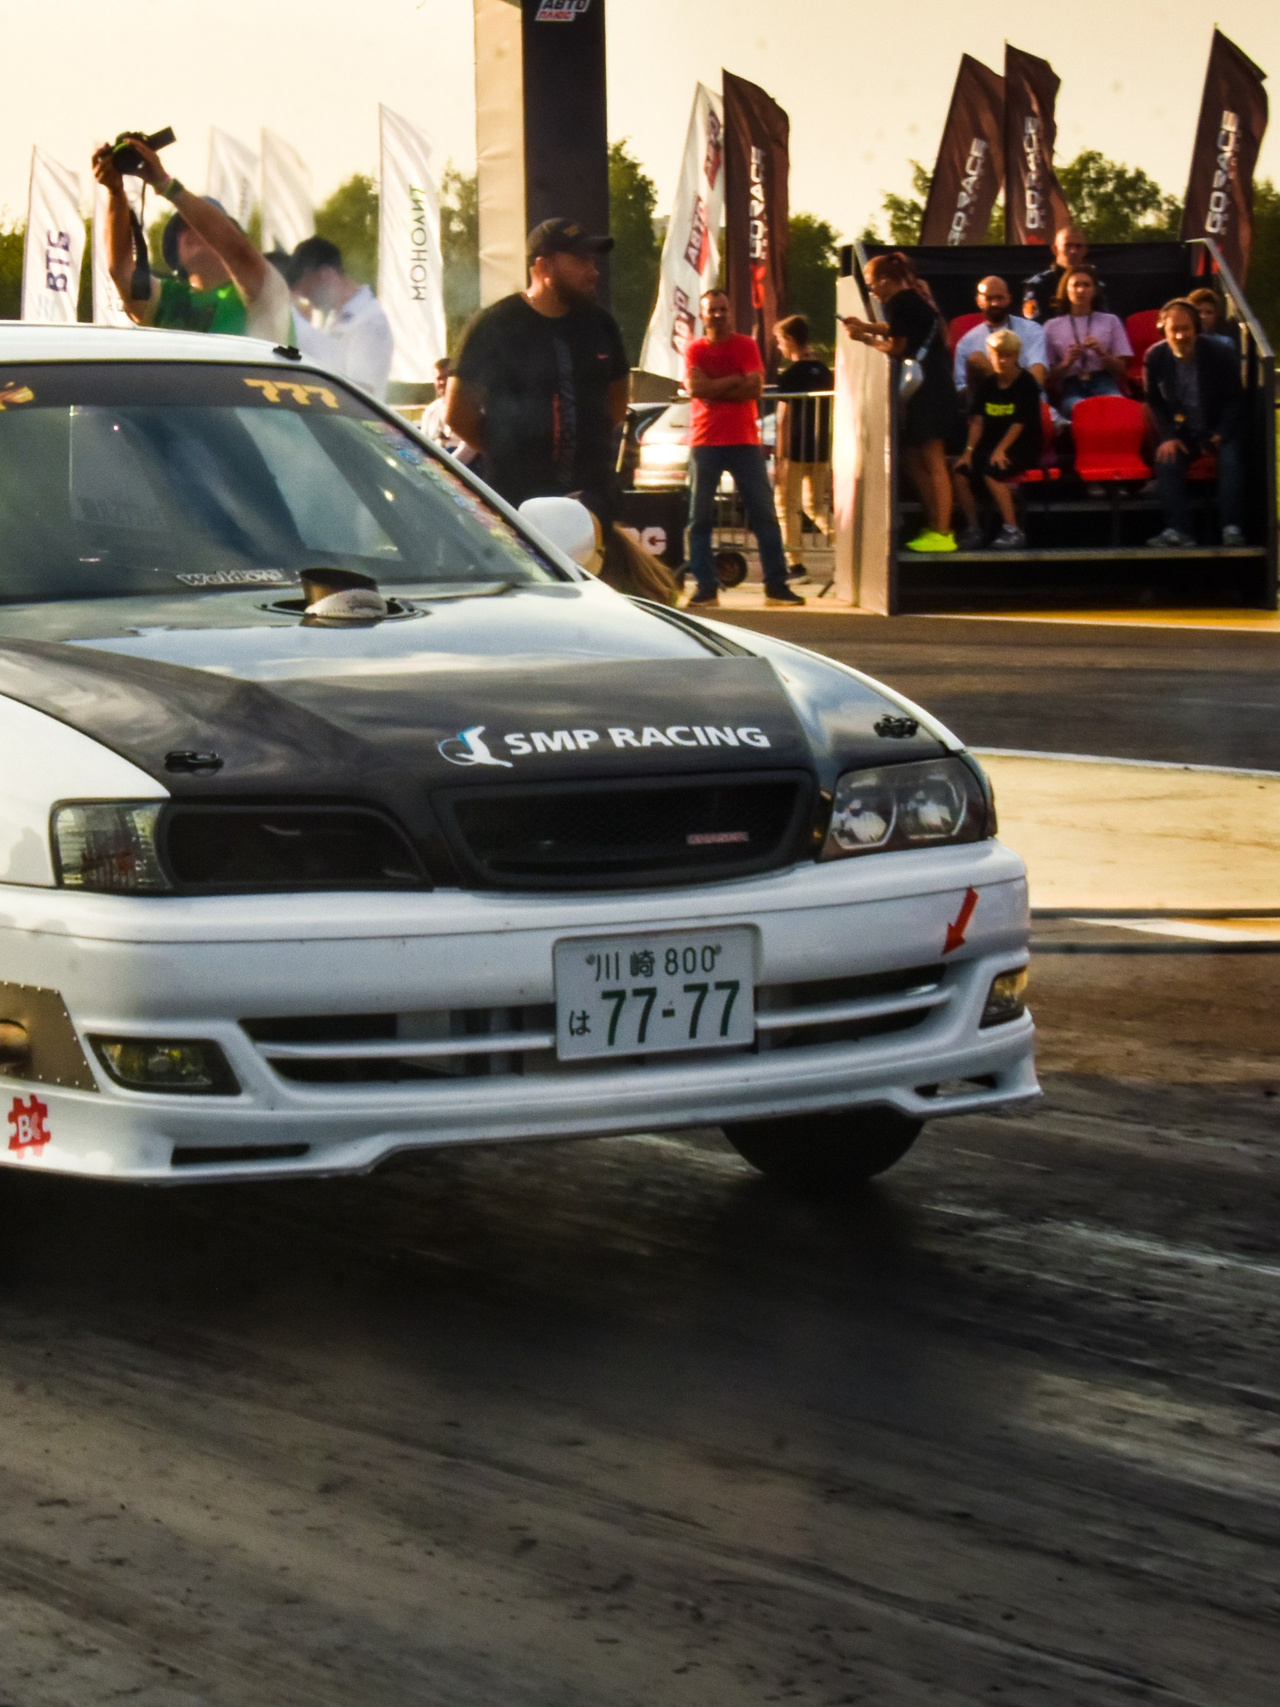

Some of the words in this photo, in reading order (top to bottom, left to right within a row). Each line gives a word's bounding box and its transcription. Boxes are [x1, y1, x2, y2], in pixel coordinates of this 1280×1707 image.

[45, 229, 70, 292] ВТБ
[408, 184, 428, 302] МОНОЛИТ
[243, 378, 339, 408] 777
[504, 729, 600, 756] SMP
[608, 726, 771, 749] RACING
[595, 950, 655, 982] 川崎
[665, 945, 715, 976] 800
[568, 1010, 591, 1036] は
[601, 980, 740, 1046] 77-77
